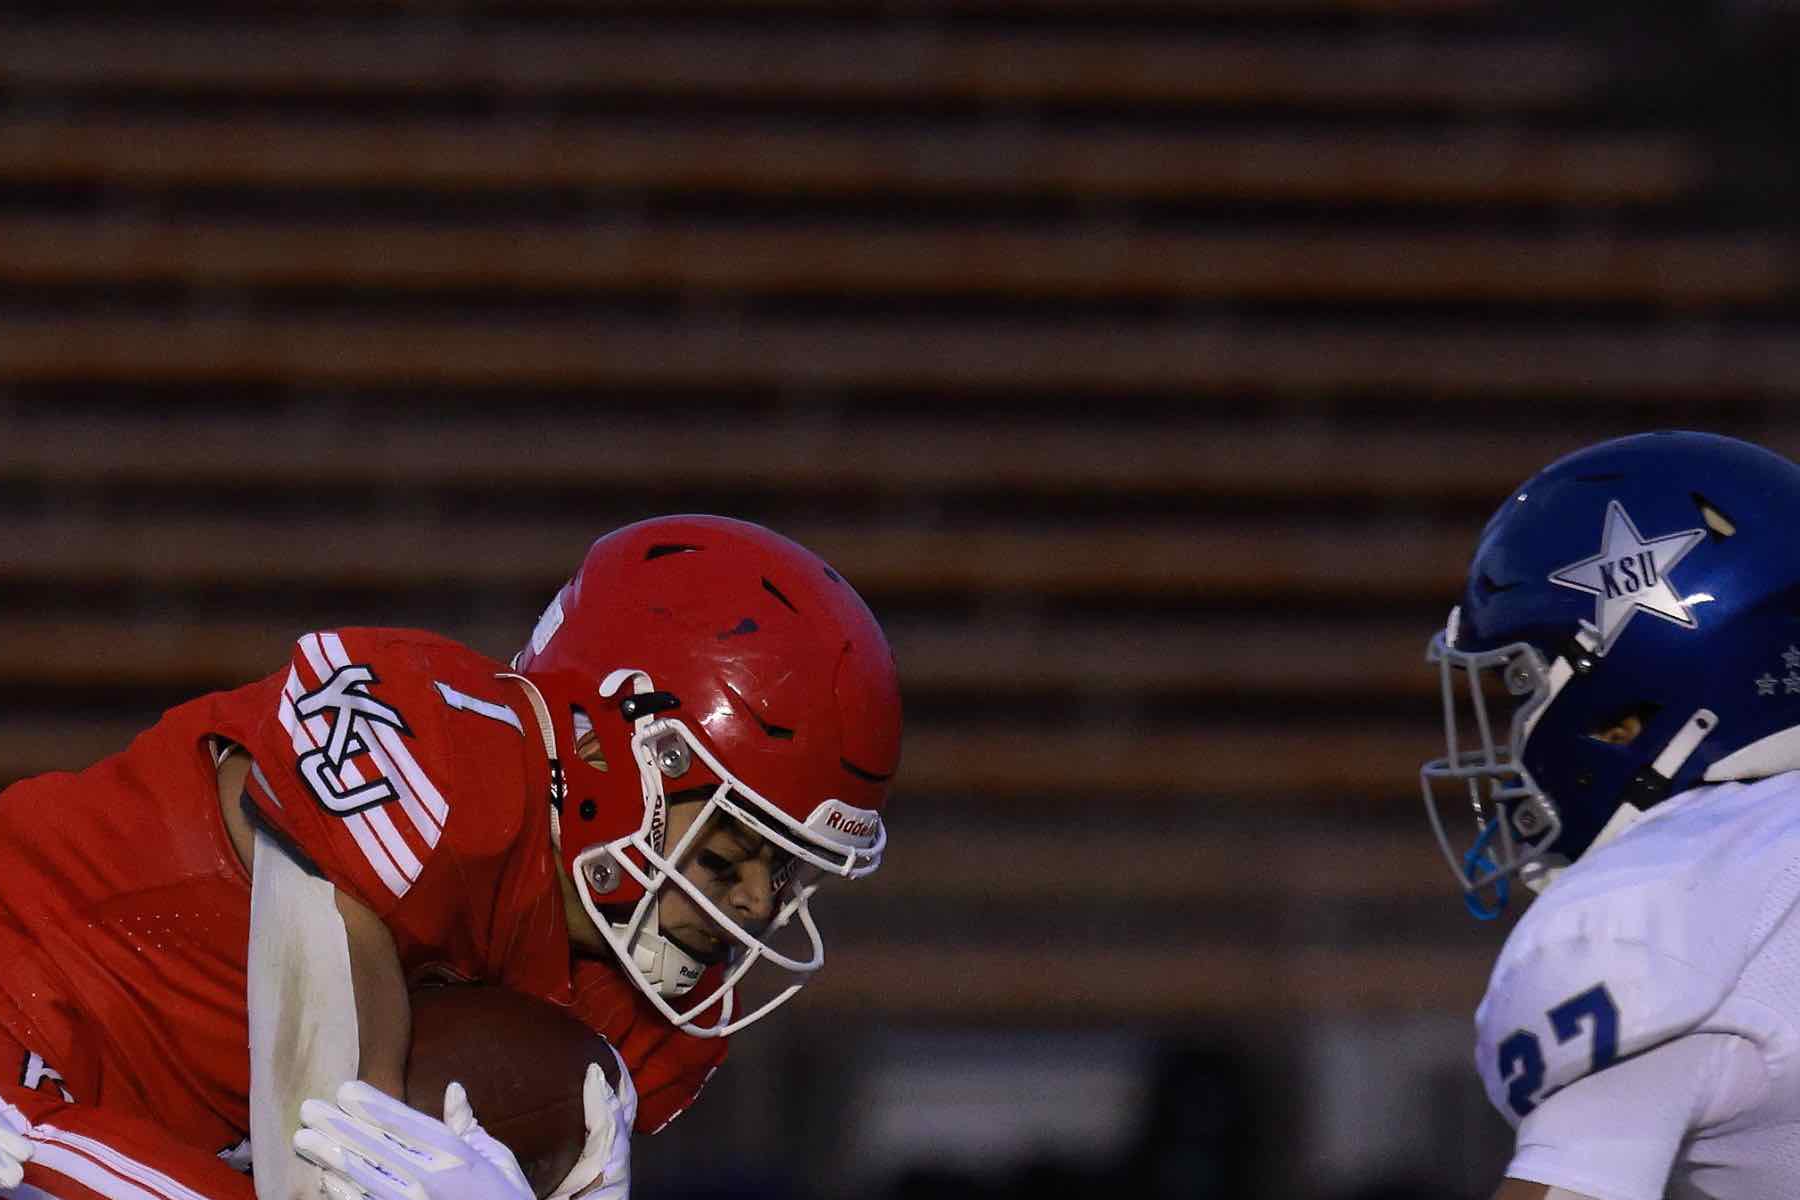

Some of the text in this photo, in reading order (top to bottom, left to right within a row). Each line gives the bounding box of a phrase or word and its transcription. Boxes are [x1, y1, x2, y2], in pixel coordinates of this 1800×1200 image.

[1598, 549, 1658, 600] KSU
[433, 680, 526, 736] 1
[1497, 980, 1620, 1118] 27
